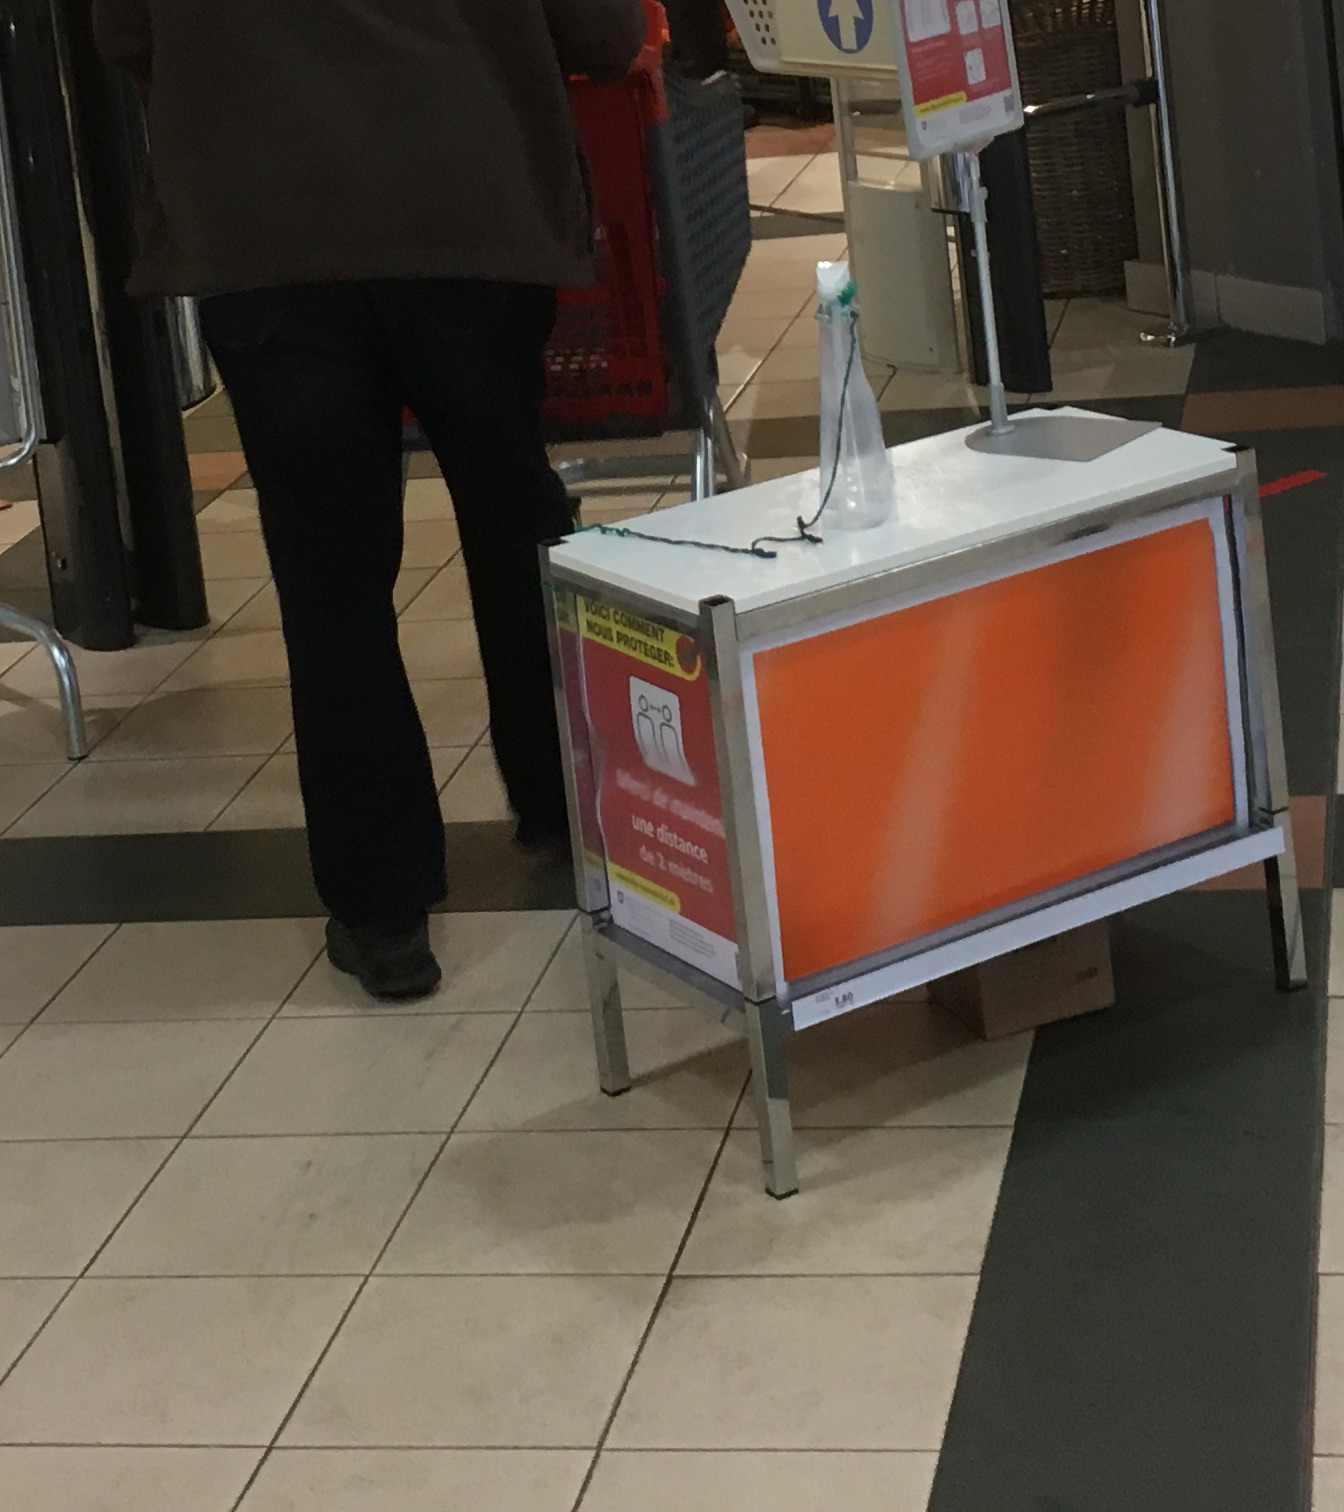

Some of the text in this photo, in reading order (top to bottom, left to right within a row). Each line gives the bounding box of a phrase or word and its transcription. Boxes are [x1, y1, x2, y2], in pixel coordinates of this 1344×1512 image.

[586, 618, 614, 642] NOUS
[612, 609, 665, 643] COMMENT
[631, 813, 709, 865] une distance
[639, 843, 655, 866] de
[656, 851, 667, 872] 2
